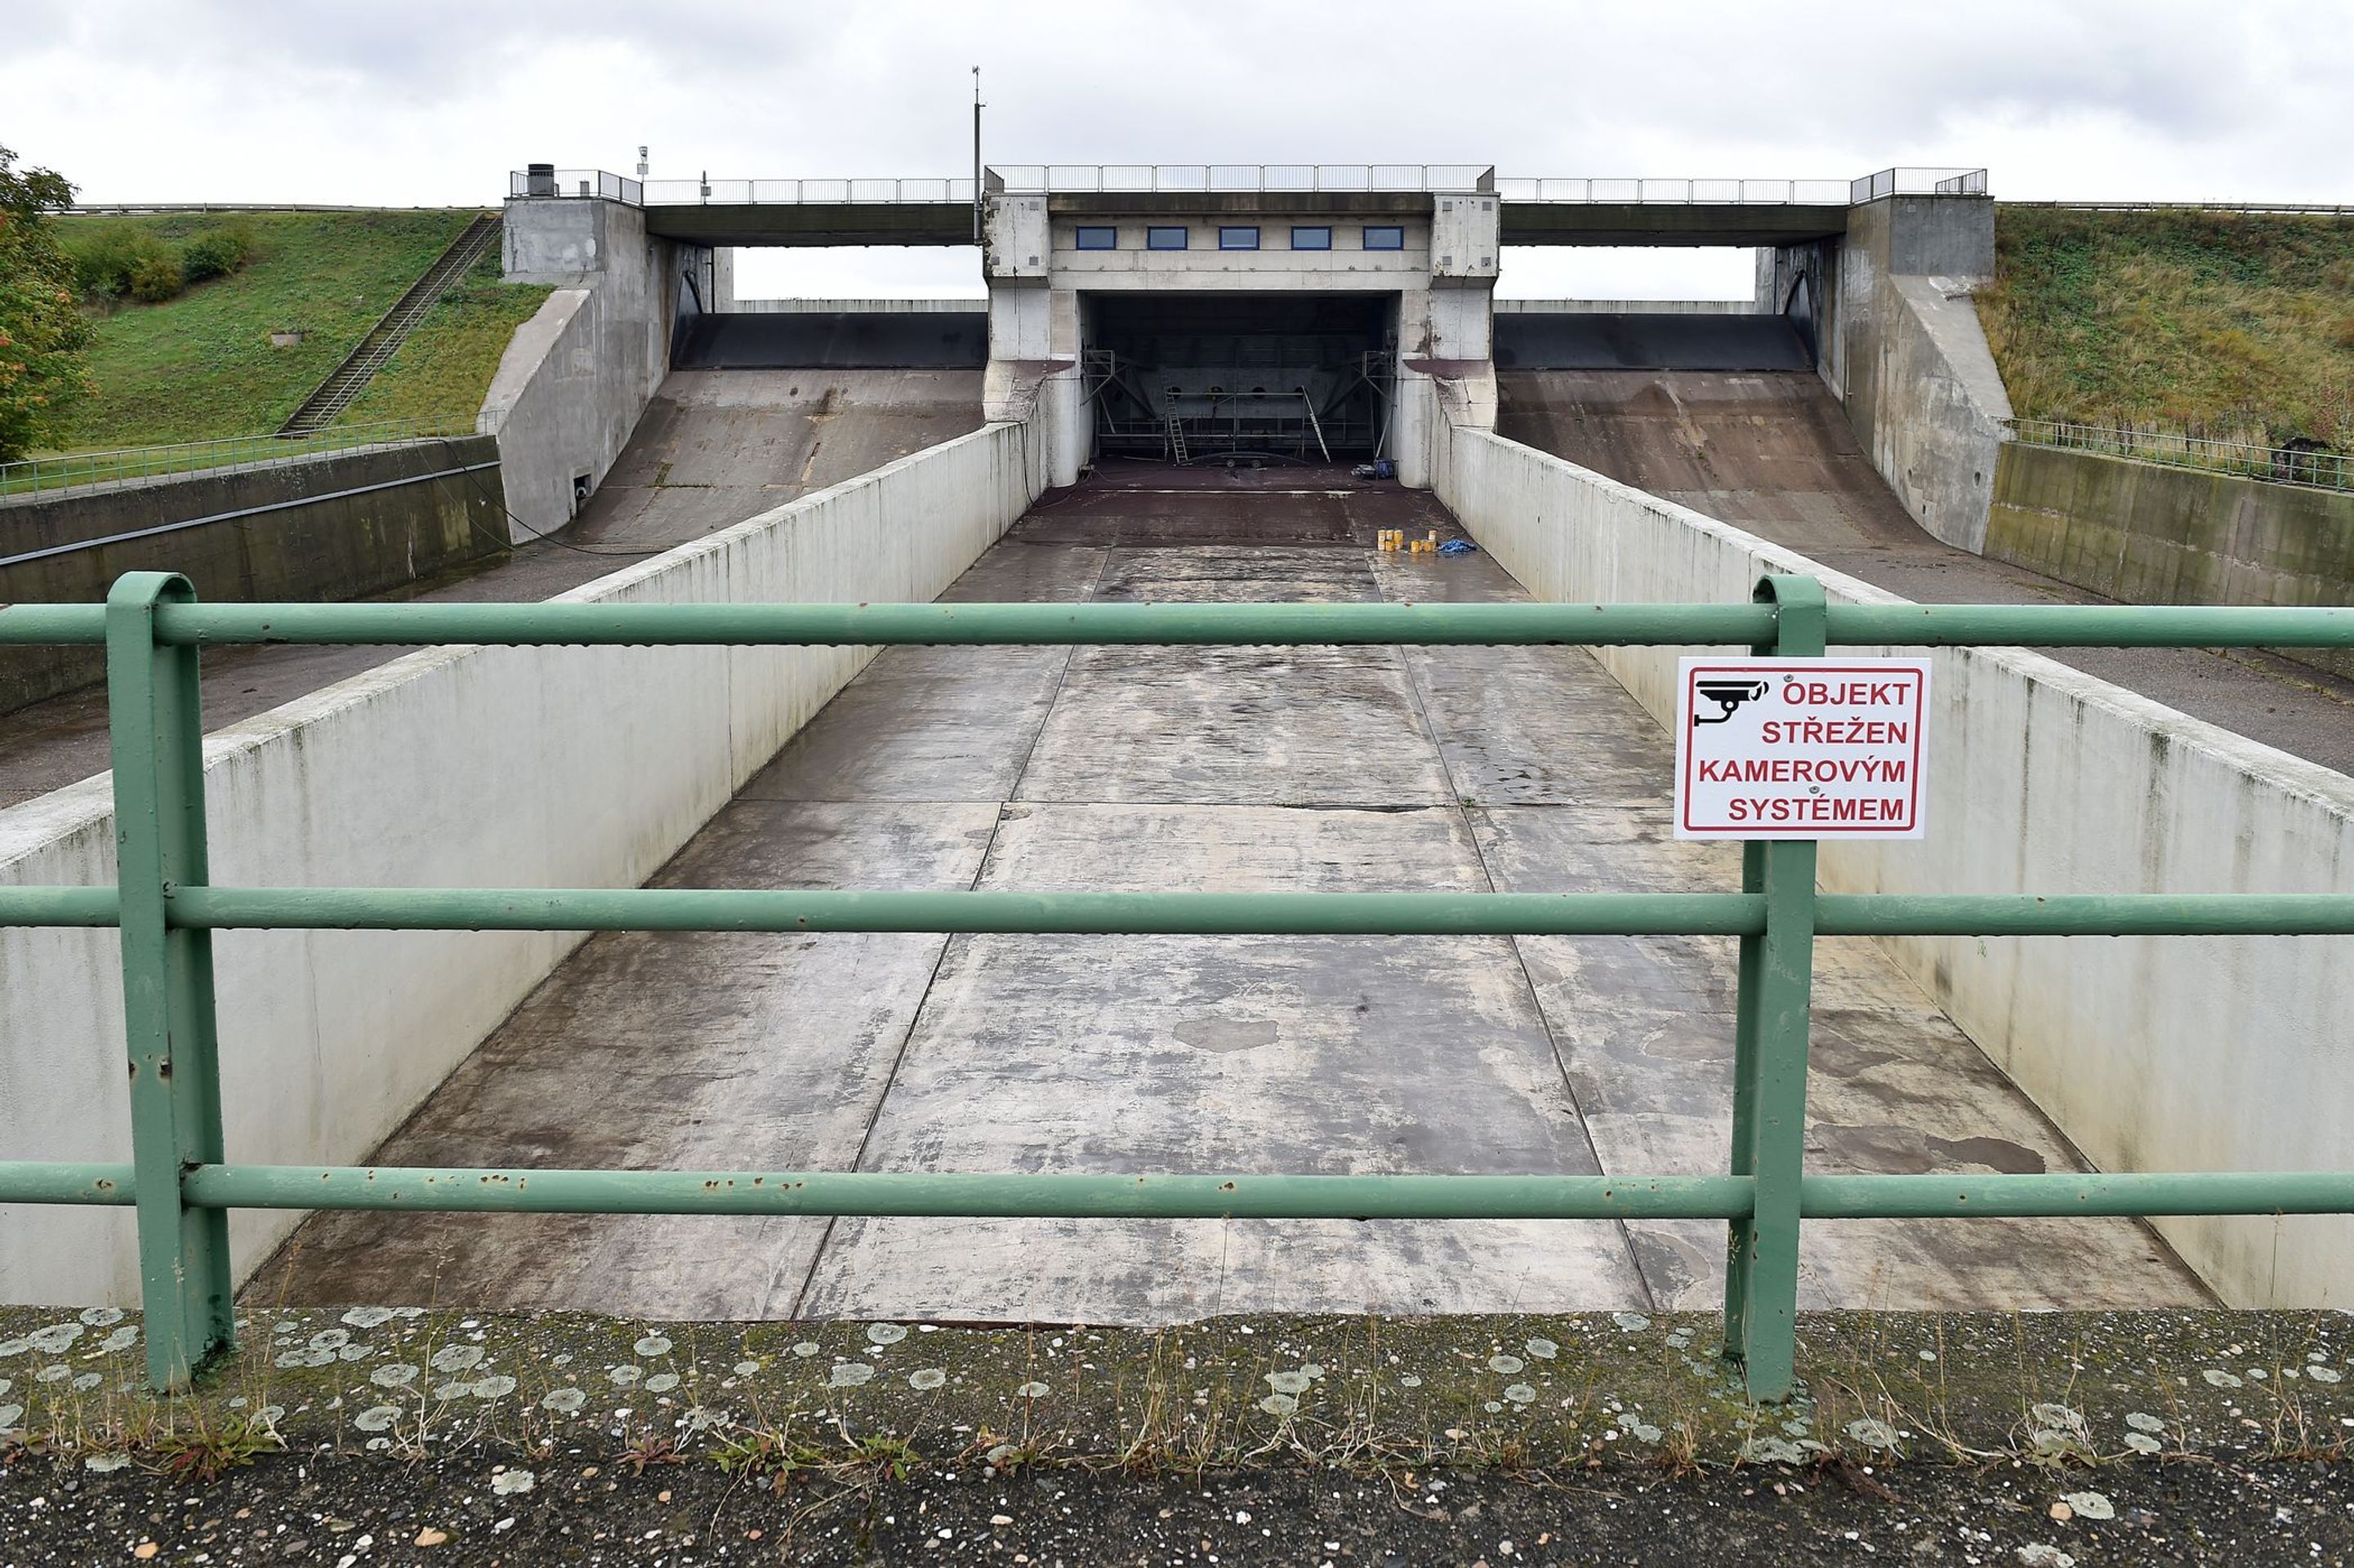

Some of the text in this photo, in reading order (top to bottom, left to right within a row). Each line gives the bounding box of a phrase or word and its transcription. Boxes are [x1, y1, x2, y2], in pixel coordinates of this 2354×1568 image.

[1782, 683, 1911, 706] OBJEKT
[1762, 716, 1908, 744] STŘEŽEN
[1699, 755, 1906, 783] KAMEROVÝM
[1728, 794, 1904, 821] SYSTÉMEM
